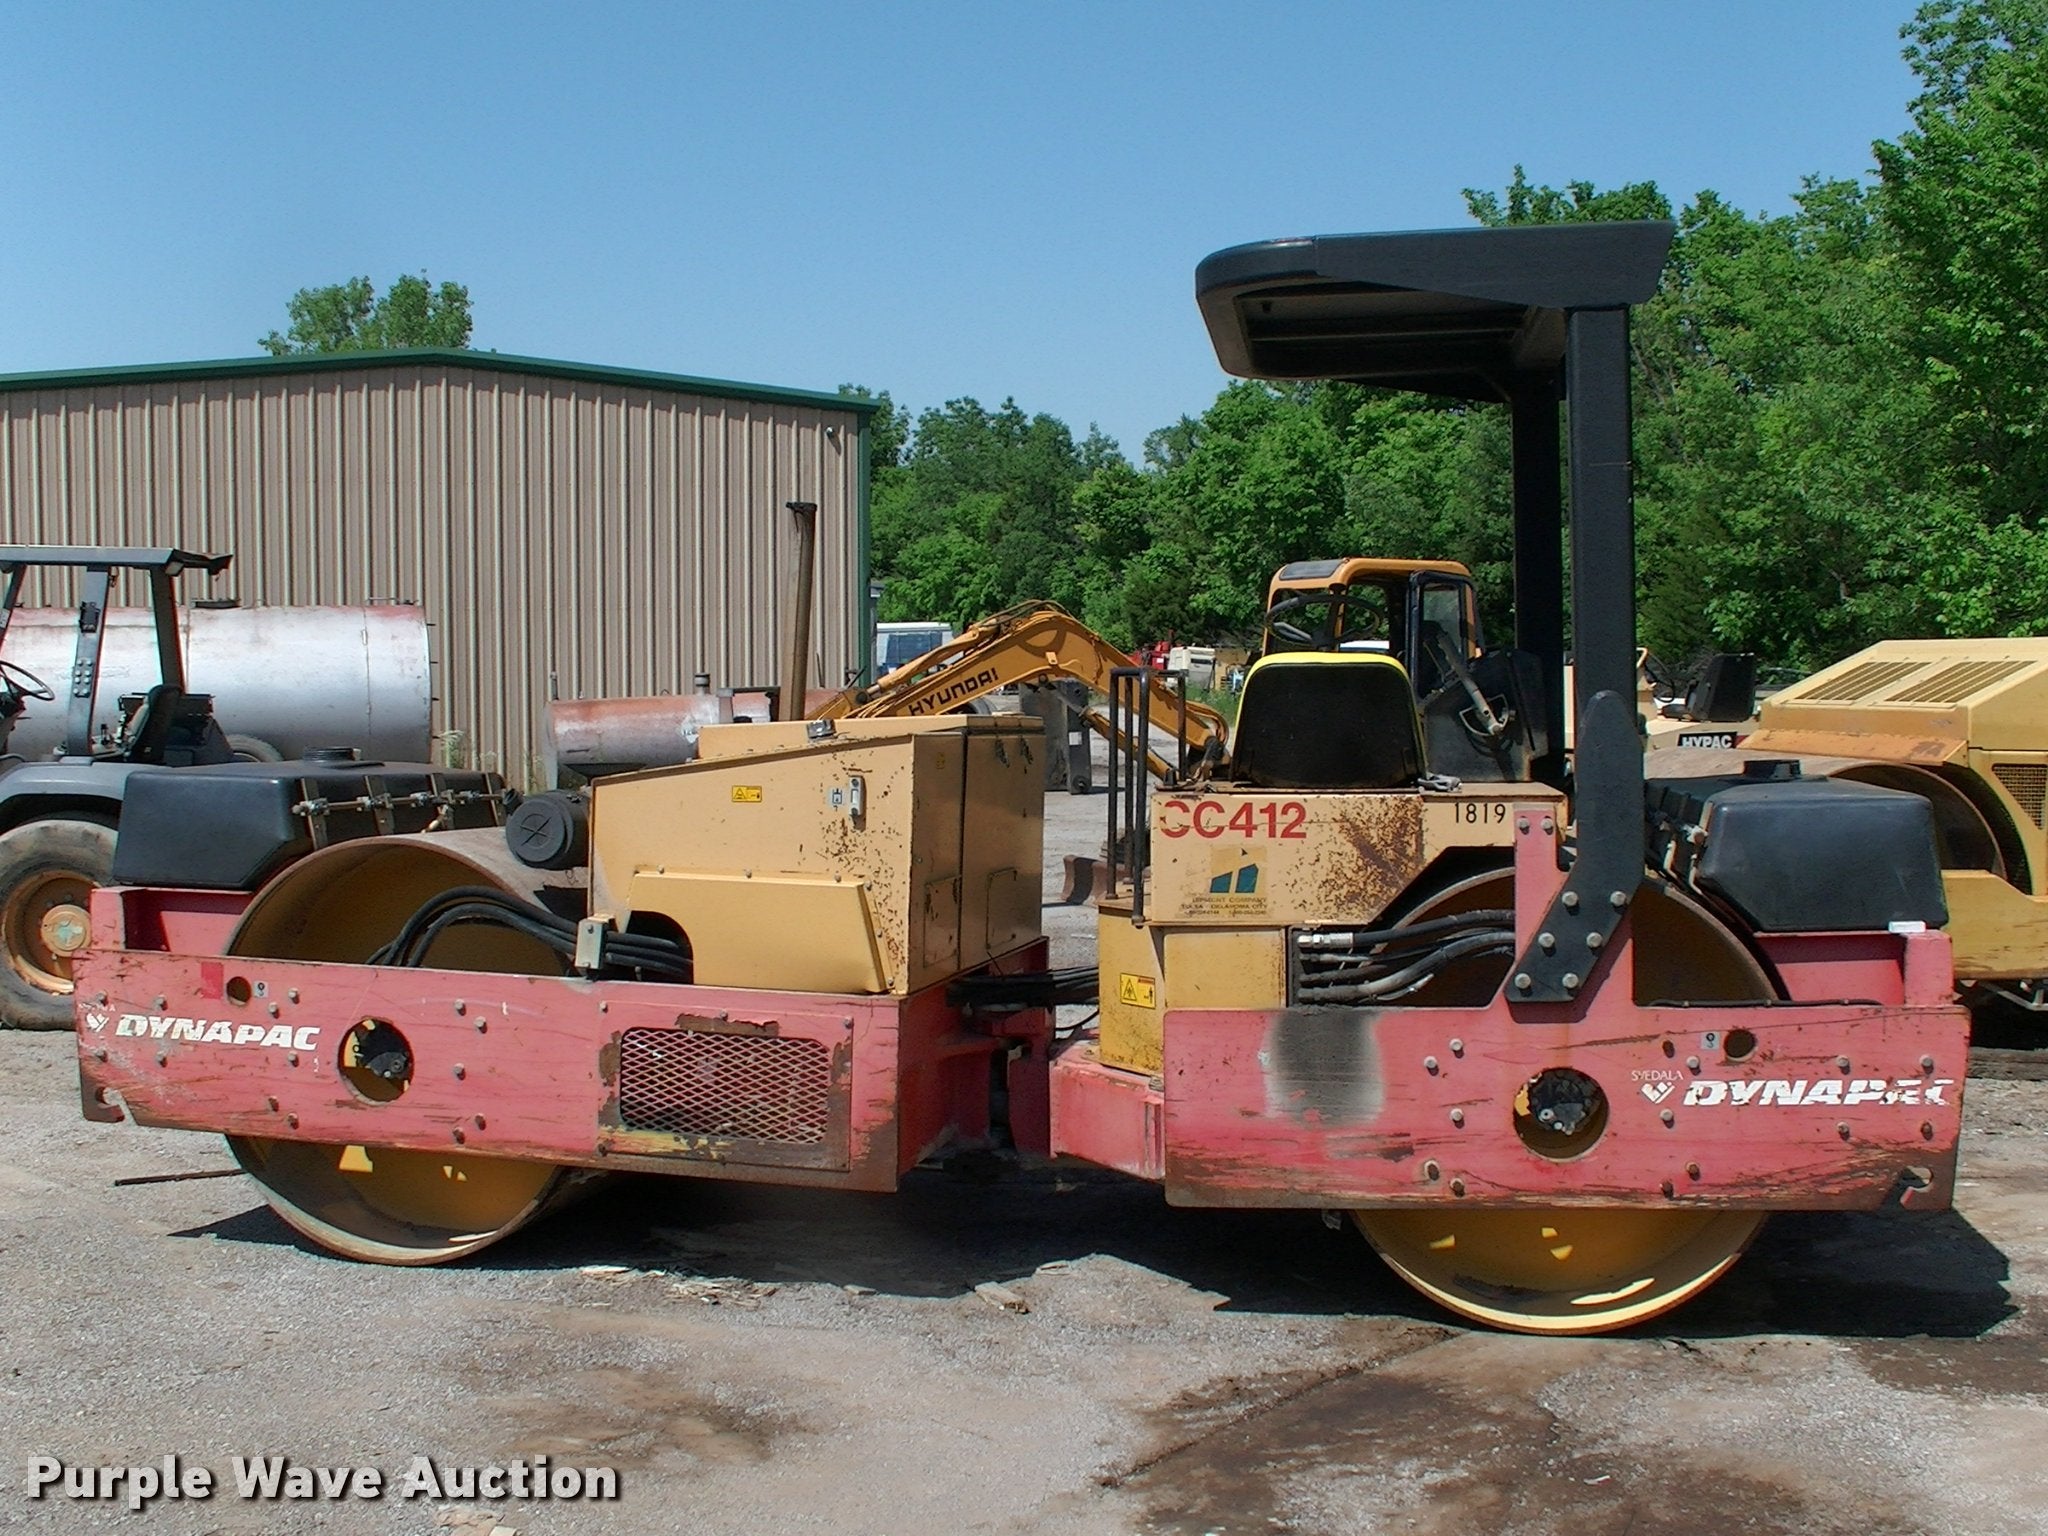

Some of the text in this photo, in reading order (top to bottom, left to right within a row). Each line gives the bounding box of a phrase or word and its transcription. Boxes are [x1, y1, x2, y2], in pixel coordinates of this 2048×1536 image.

[908, 667, 1000, 716] HYUNDAI
[1682, 734, 1733, 749] HYPAC
[1159, 801, 1307, 839] CC412
[1453, 802, 1506, 824] 1819
[114, 1014, 321, 1050] DYNAPAC
[1631, 1069, 1684, 1081] SVEDALA
